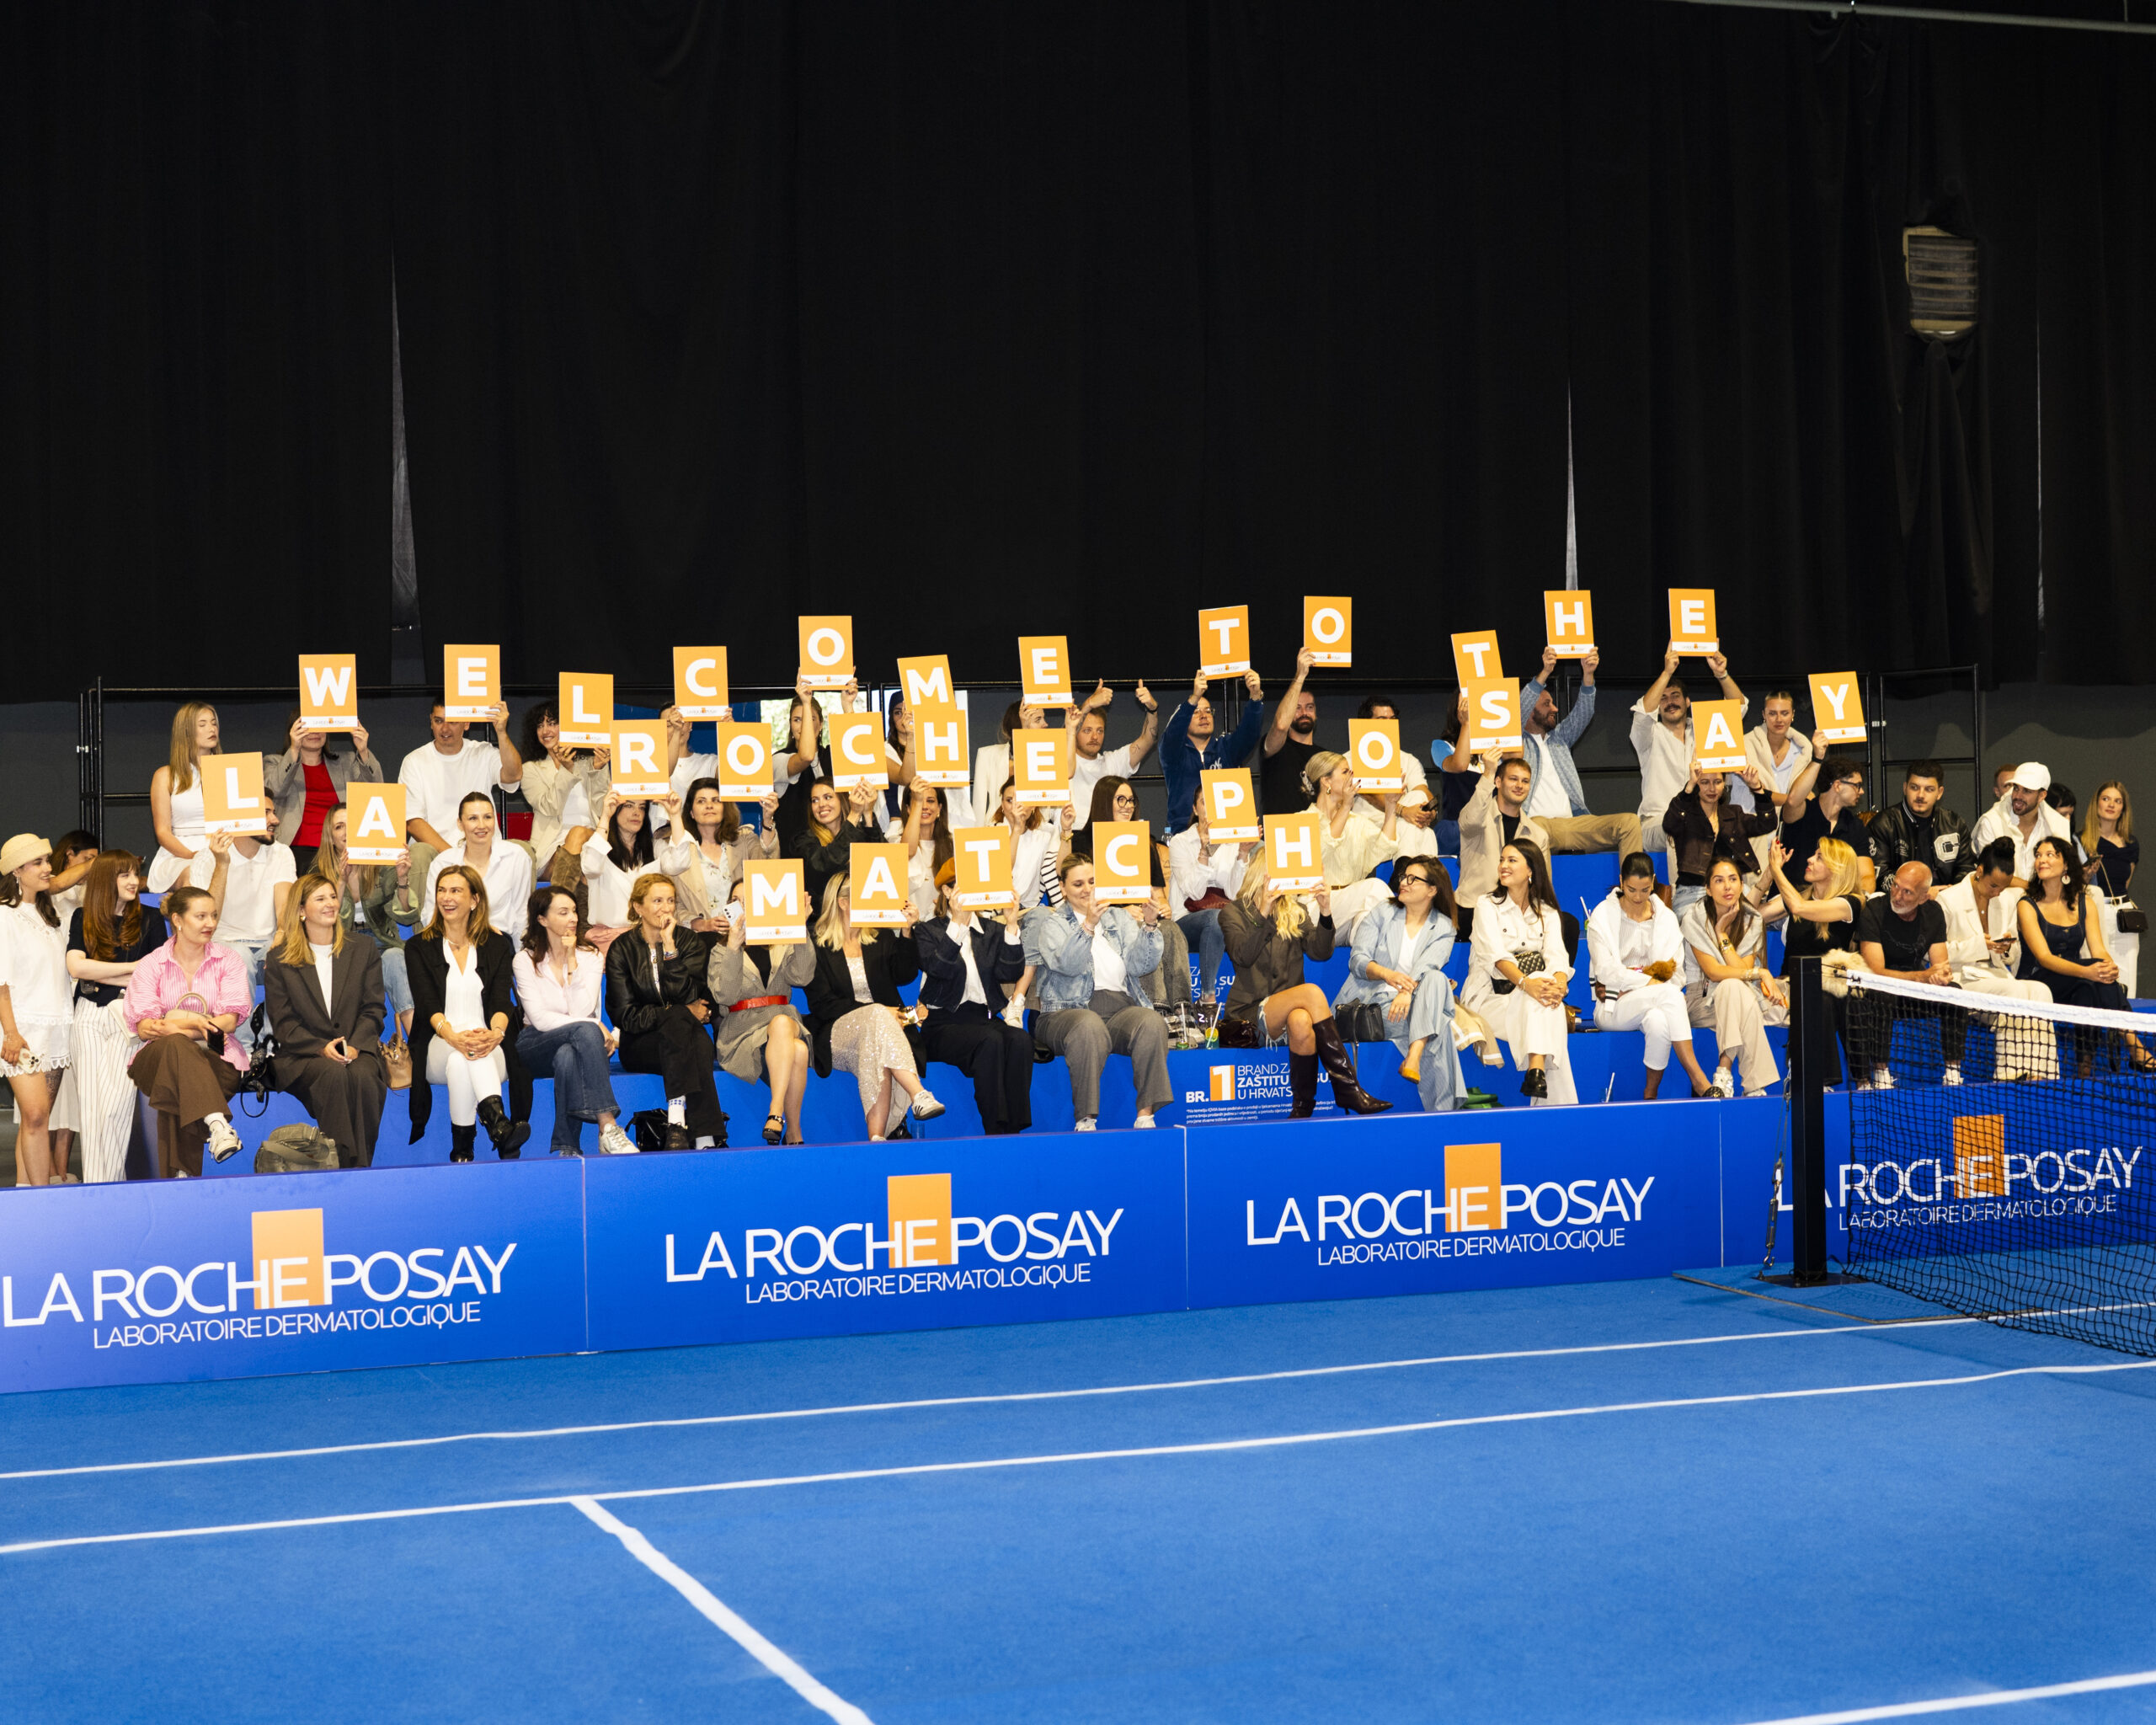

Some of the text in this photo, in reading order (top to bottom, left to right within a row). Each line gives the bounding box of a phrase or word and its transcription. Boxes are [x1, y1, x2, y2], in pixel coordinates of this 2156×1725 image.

[1312, 608, 1344, 643] O
[1555, 602, 1584, 635] H
[1681, 601, 1705, 633] E
[808, 628, 845, 665] O
[1209, 619, 1239, 654] T
[458, 658, 487, 696] E
[686, 659, 717, 697] C
[1032, 649, 1059, 684] E
[1463, 643, 1490, 676] T
[304, 667, 351, 706] W
[573, 686, 600, 723] L
[906, 667, 948, 705] M
[1821, 684, 1848, 719] Y
[1481, 692, 1510, 729] S
[842, 725, 875, 764] C
[924, 723, 958, 761] H
[1705, 713, 1736, 749] A
[619, 733, 659, 773] R
[727, 735, 764, 775] O
[1027, 742, 1055, 780] E
[1358, 732, 1393, 769] O
[226, 767, 259, 809] L
[1213, 782, 1244, 819] P
[357, 797, 396, 837] A
[965, 840, 1000, 881] T
[1106, 835, 1139, 876] C
[1275, 826, 1311, 868] H
[752, 873, 798, 916] M
[861, 857, 899, 899] A
[1186, 1065, 1231, 1103] BR. 1
[1237, 1063, 1290, 1076] BRAND Z
[1237, 1074, 1289, 1088] ZAŠTITU
[1238, 1086, 1294, 1100] U HRVATS
[1838, 1155, 1995, 1207] ROCHE
[2004, 1146, 2143, 1196] POSAY
[1246, 1177, 1655, 1246] LA ROCHE POSAY
[1838, 1194, 2117, 1231] LABORATOIRE DERMATOLOGIQUE
[666, 1208, 1124, 1283] LA ROCHE POSAY
[1318, 1228, 1625, 1266] LABORATOIRE DERMATOLOGIQUE
[3, 1242, 517, 1328] LA ROCHE POSAY
[746, 1263, 1091, 1304] LABORATOIRE DERMATOLOGIQUE
[93, 1301, 481, 1349] LABORATOIRE DERMATOLOGIQUE
